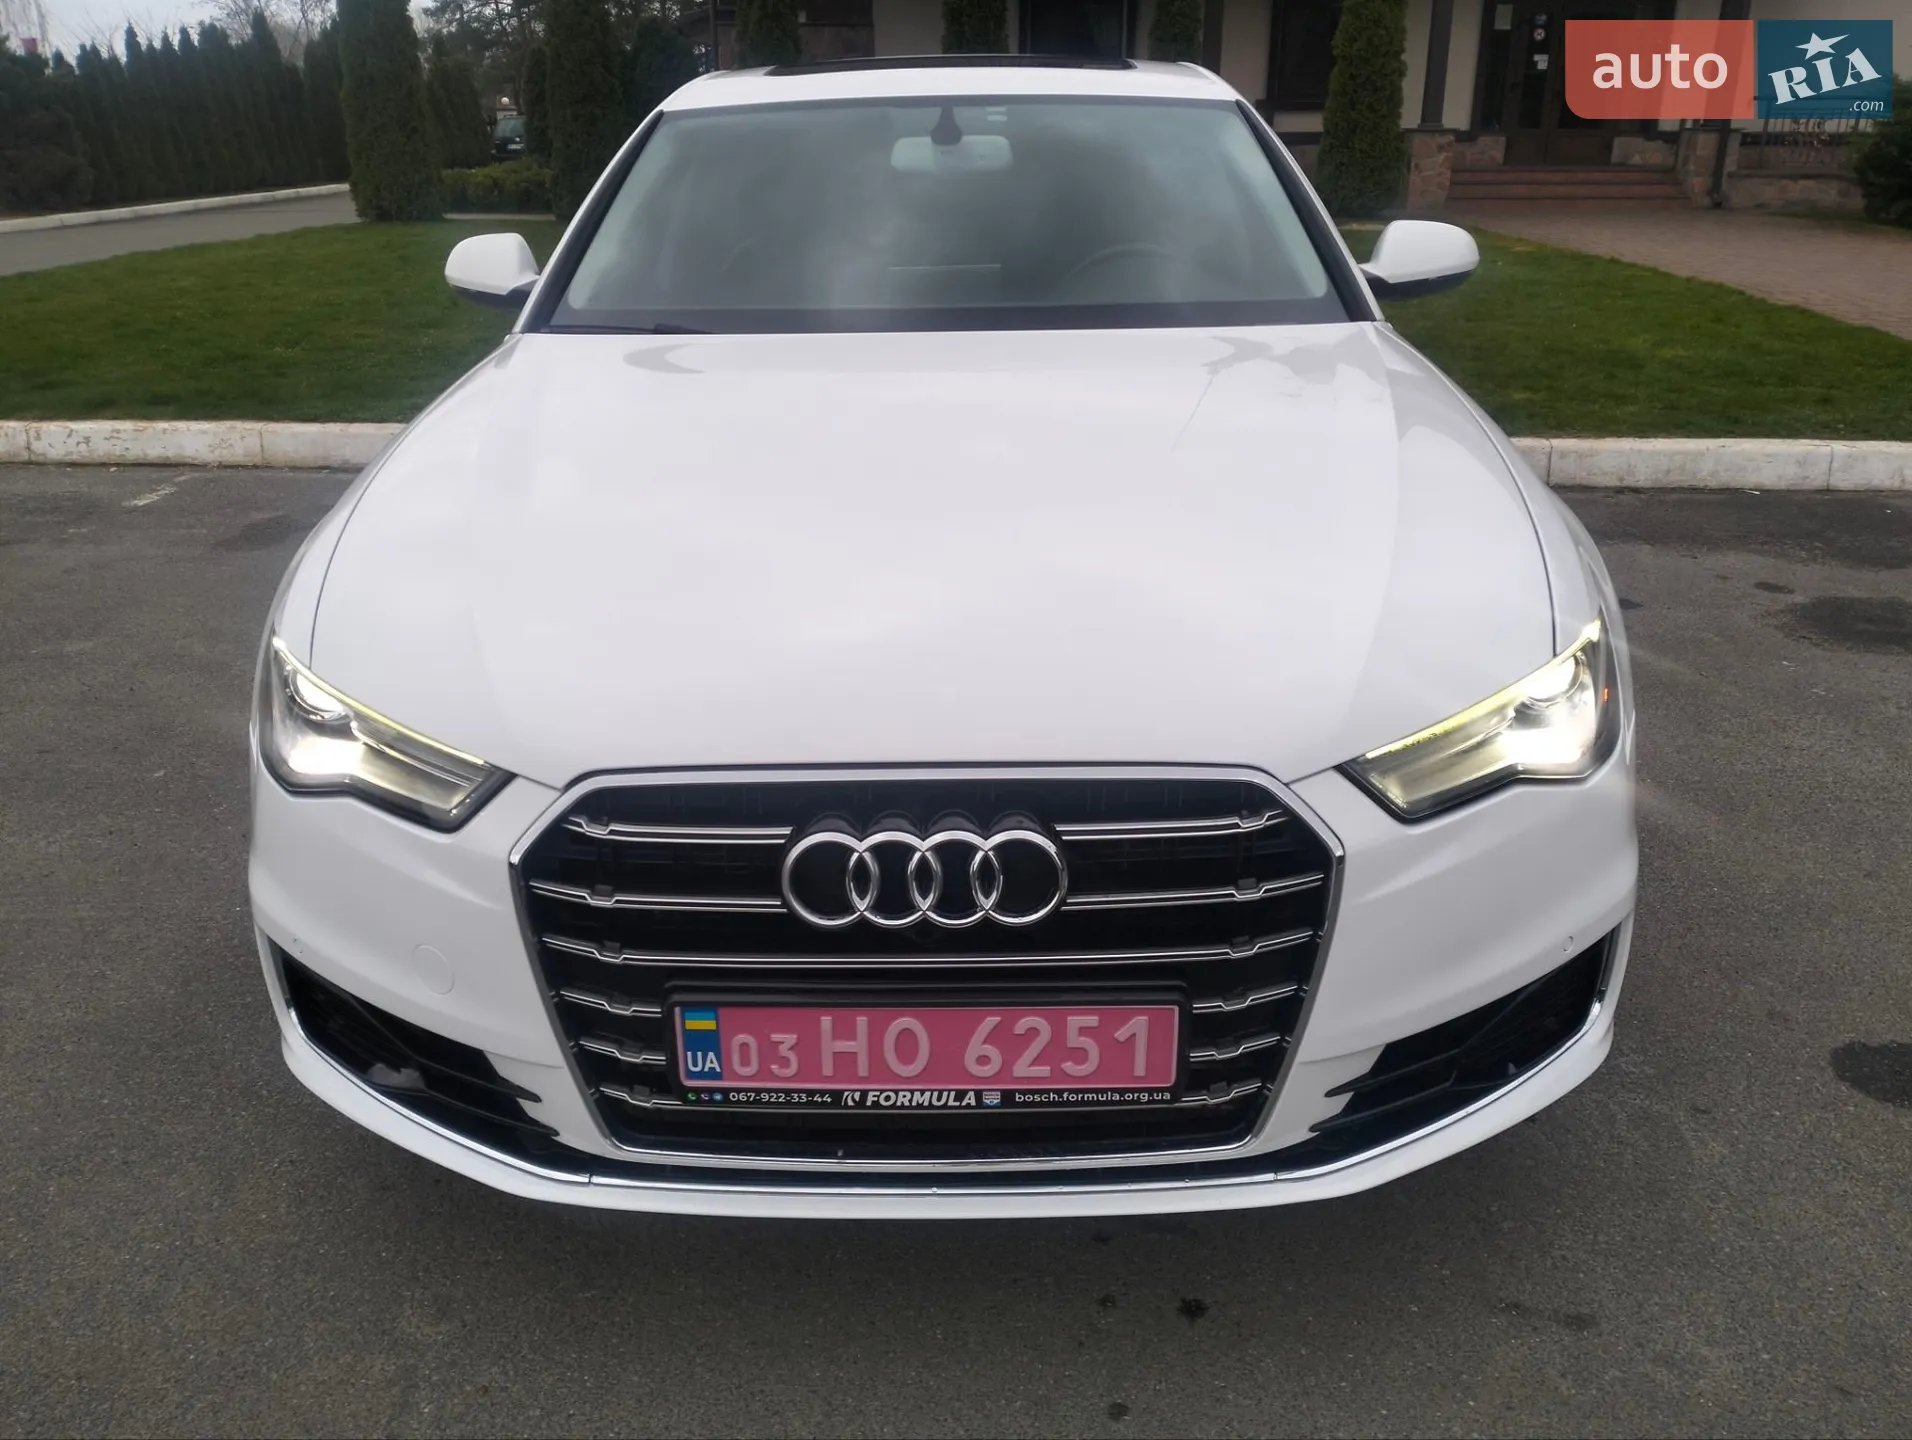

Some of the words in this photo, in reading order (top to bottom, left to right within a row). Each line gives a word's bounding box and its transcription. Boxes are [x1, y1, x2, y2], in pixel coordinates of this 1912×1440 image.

[730, 1033, 799, 1078] 03
[820, 1016, 930, 1078] HO
[964, 1016, 1149, 1078] 6251
[686, 1051, 722, 1073] UA
[729, 1091, 833, 1103] 067-922-33-44
[865, 1090, 977, 1107] FORMULA
[1015, 1091, 1171, 1102] bosch.formula.org.ua
